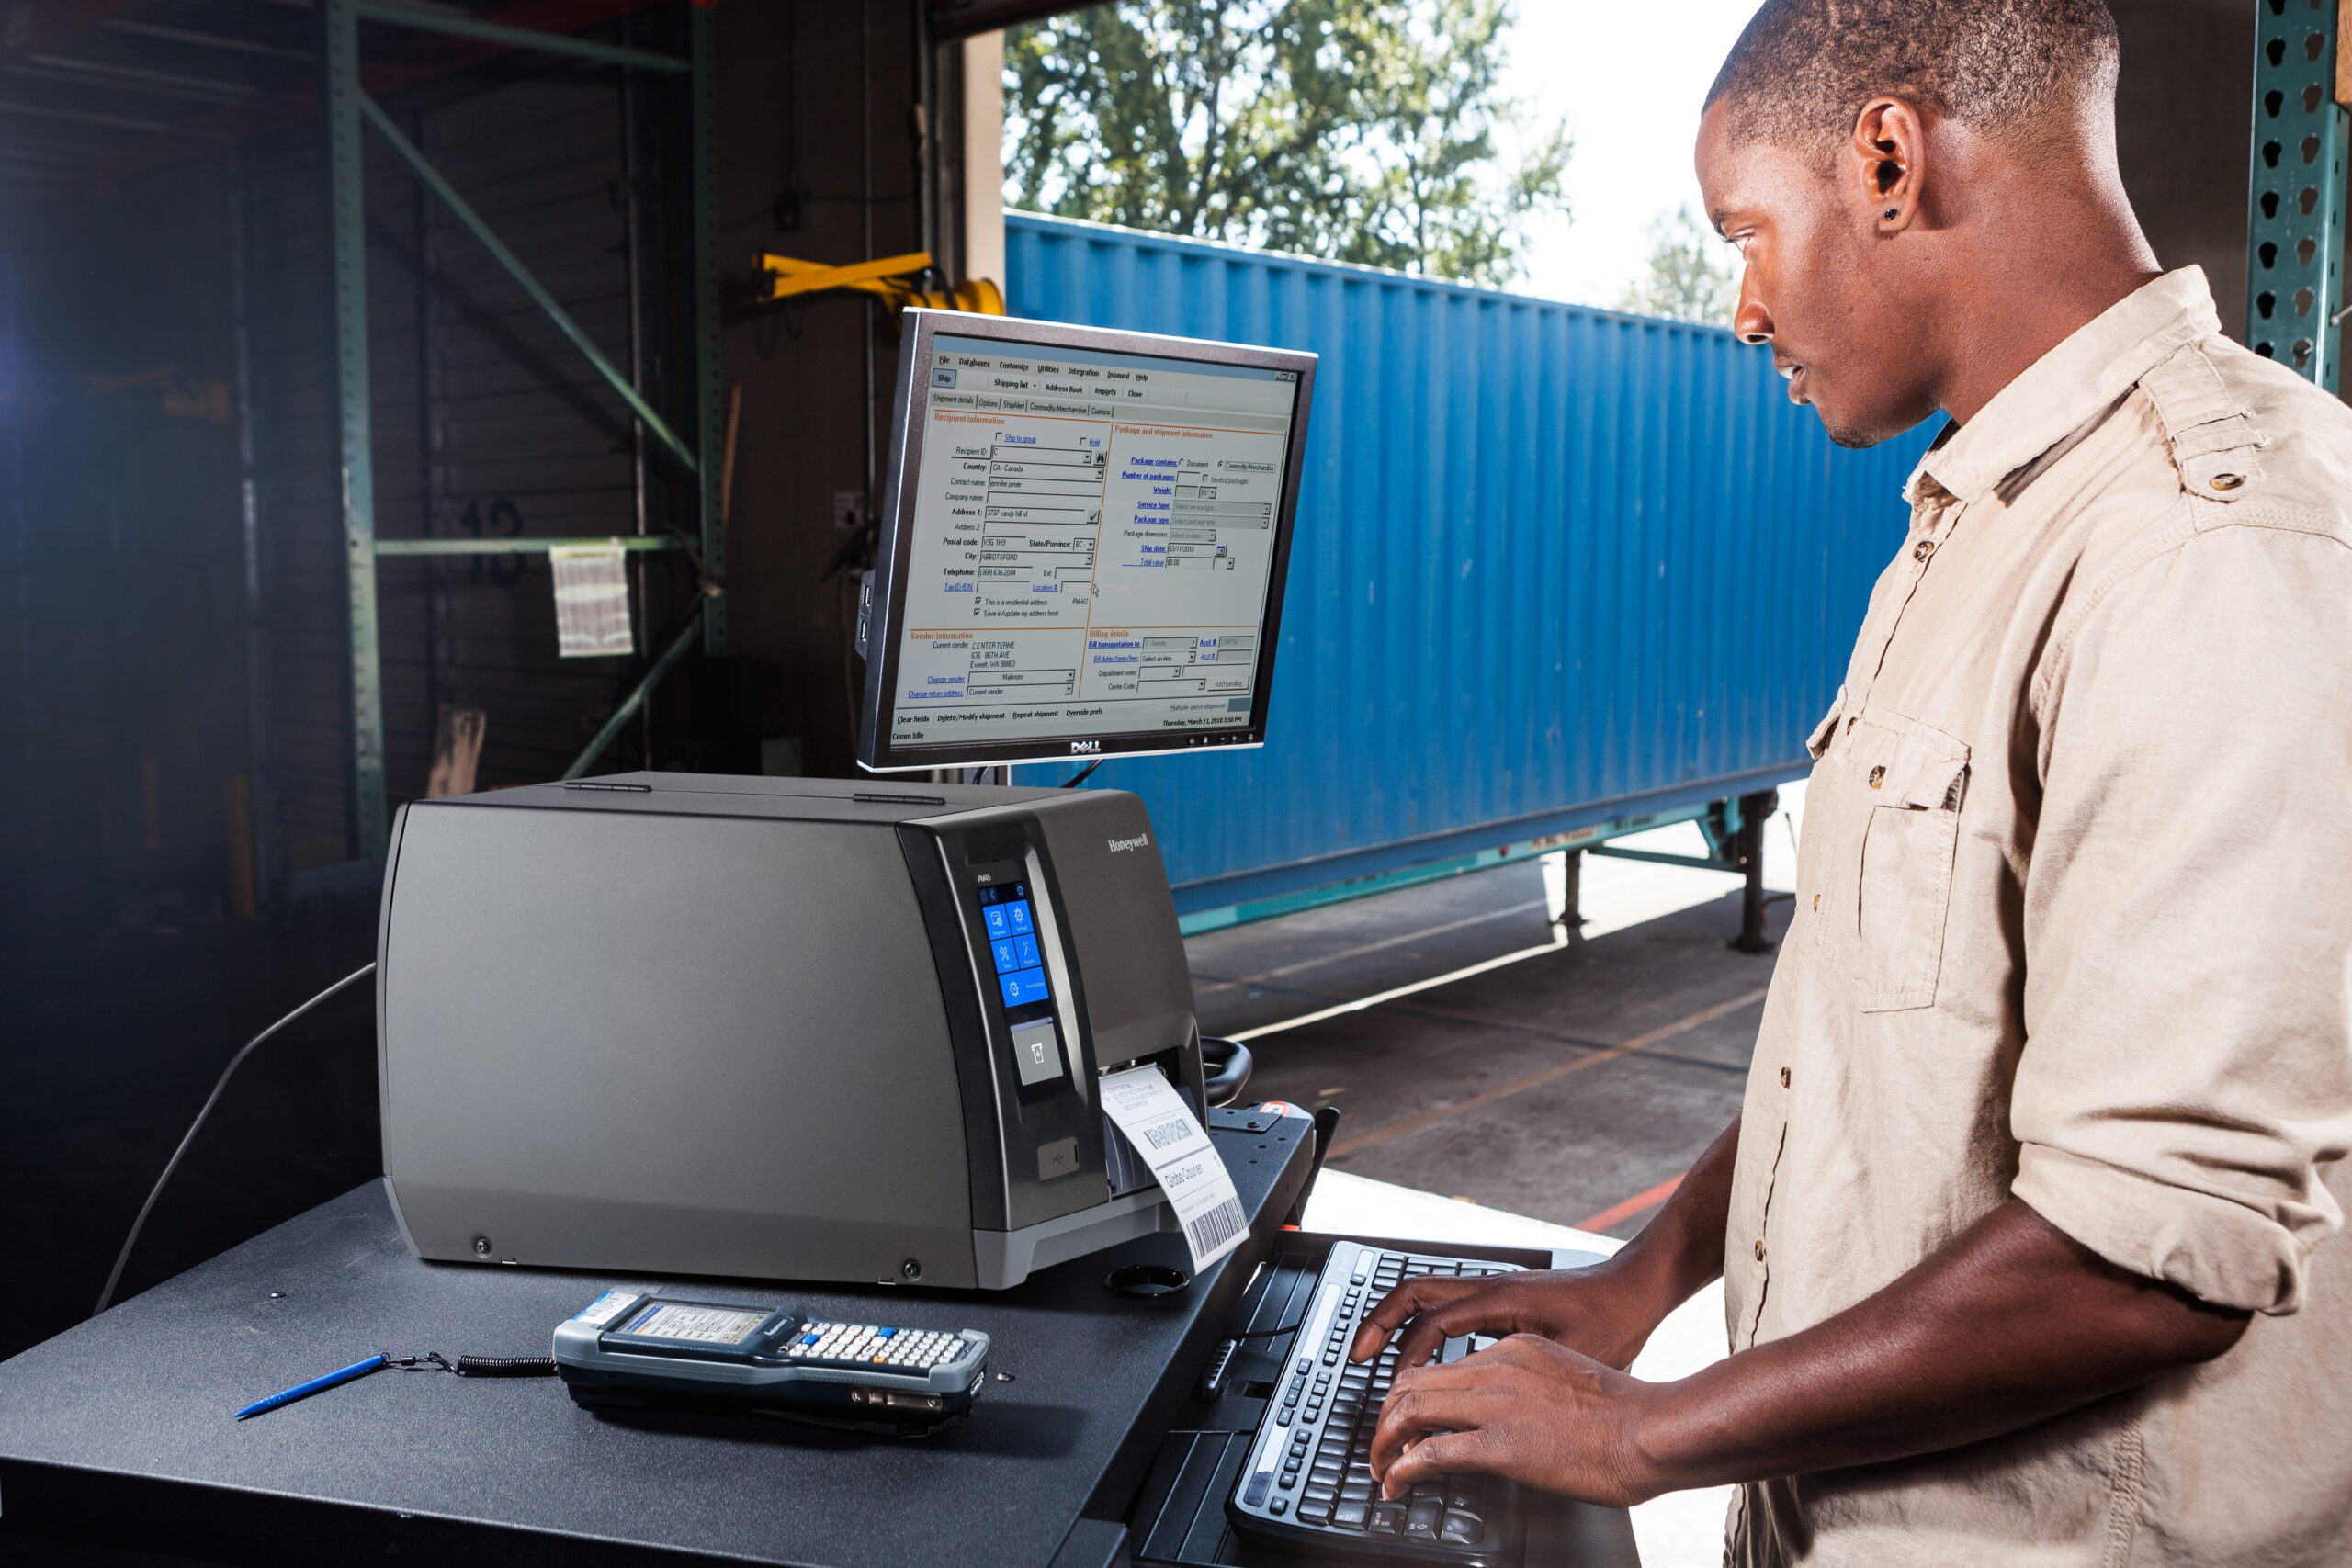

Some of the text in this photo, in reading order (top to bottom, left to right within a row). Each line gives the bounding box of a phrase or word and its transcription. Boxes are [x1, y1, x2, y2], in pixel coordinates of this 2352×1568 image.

[959, 358, 990, 367] Databases
[1000, 362, 1029, 371] Customize
[1038, 365, 1059, 373] Utilities
[1068, 367, 1099, 377] Integration
[938, 375, 951, 383] Ship
[1107, 371, 1129, 379] Inbound
[994, 379, 1018, 389] Shipping
[1046, 384, 1068, 392] Address
[1095, 388, 1116, 396] Reports
[933, 394, 956, 403] Shipment
[979, 399, 998, 408] Options
[1003, 400, 1024, 409] ShipAlert
[934, 412, 1005, 424] Recipient information
[1115, 425, 1140, 435] Package
[1154, 428, 1180, 437] shipment
[1182, 430, 1213, 439] information
[1004, 434, 1016, 443] Ship
[956, 446, 979, 455] Recipient
[1131, 457, 1154, 465] Package
[963, 462, 987, 471] Country:
[1122, 471, 1142, 479] Number
[1150, 473, 1175, 481] packages:
[1153, 486, 1172, 494] Weight:
[945, 492, 968, 502] Company
[1137, 502, 1157, 510] Service
[1134, 515, 1157, 524] Package
[1140, 545, 1151, 553] Ship
[944, 569, 976, 577] Telephone:
[944, 583, 955, 592] Tax
[1090, 630, 1108, 639] Billing
[927, 676, 946, 684] Change
[937, 713, 1005, 722] Delete/Modify shipment
[1012, 711, 1033, 719] Repeat
[1163, 717, 1186, 726] Thursday,
[1071, 740, 1101, 753] DELL
[1108, 832, 1148, 852] Honeywell
[1165, 1162, 1204, 1188] Globe Courier
